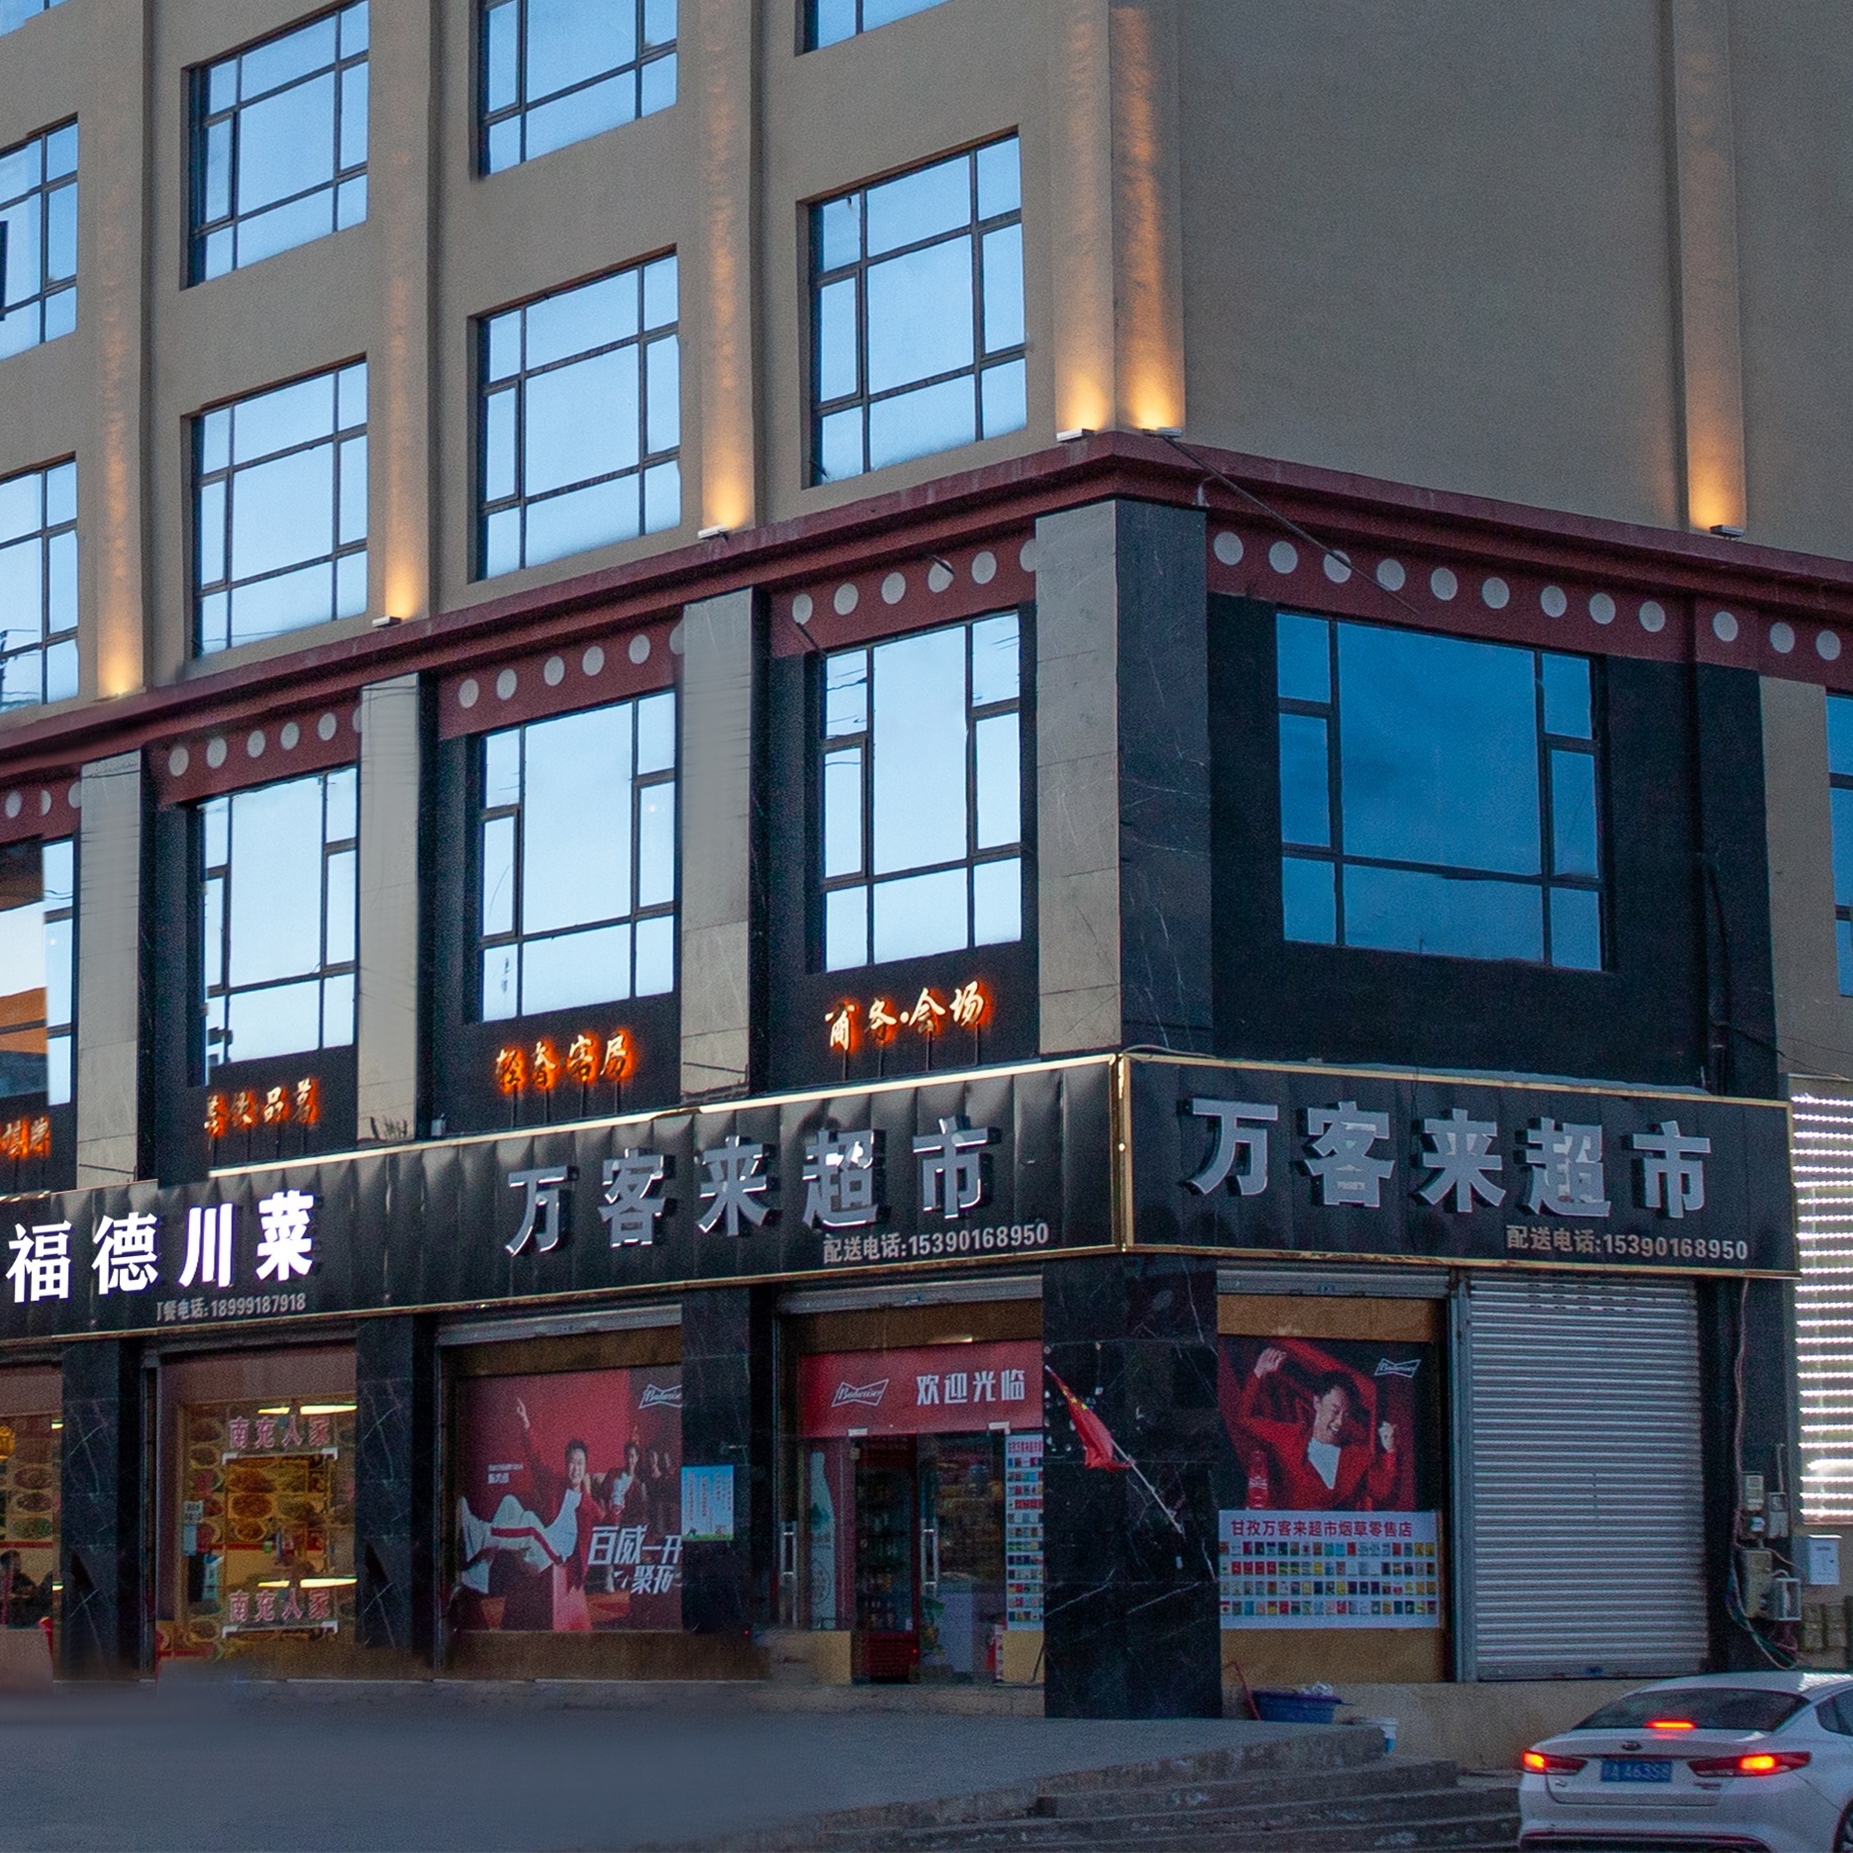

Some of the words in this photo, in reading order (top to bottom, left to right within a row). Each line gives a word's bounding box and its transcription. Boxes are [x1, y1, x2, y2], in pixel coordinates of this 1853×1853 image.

[1183, 1098, 1711, 1219] 万客来超市
[506, 1116, 998, 1258] 万客来超市
[823, 1223, 1048, 1264] 配送电话:15390168950
[1506, 1225, 1748, 1260] 配送电话:15390168950
[916, 1369, 1026, 1406] 欢迎光临
[228, 1415, 331, 1447] 南充人家
[587, 1524, 682, 1565] 百威一开
[1231, 1520, 1414, 1538] 甘孜万客来超市烟草零售店
[228, 1588, 331, 1622] 南充人家
